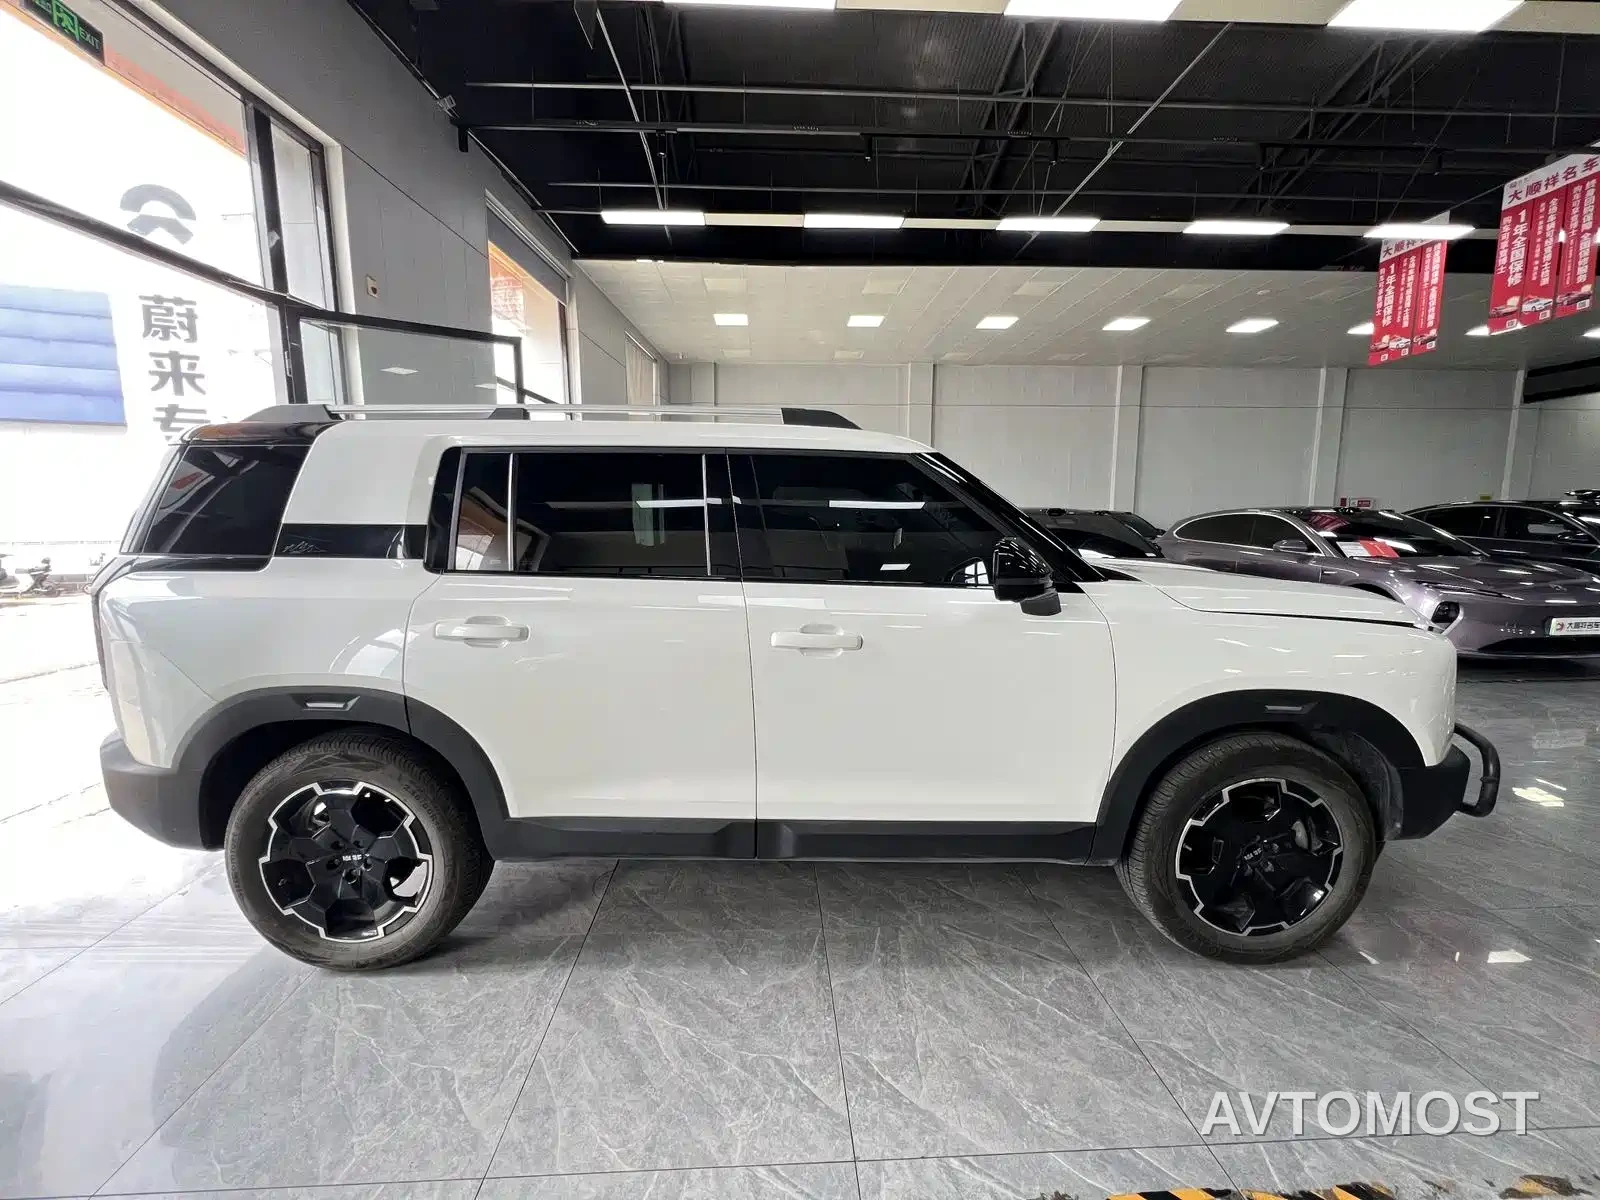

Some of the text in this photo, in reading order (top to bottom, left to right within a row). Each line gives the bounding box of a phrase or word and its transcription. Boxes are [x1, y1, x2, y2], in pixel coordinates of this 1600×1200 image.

[80, 27, 100, 49] EXIT
[1508, 156, 1600, 205] 大顺祥名车
[1507, 209, 1528, 287] 1年全国保修
